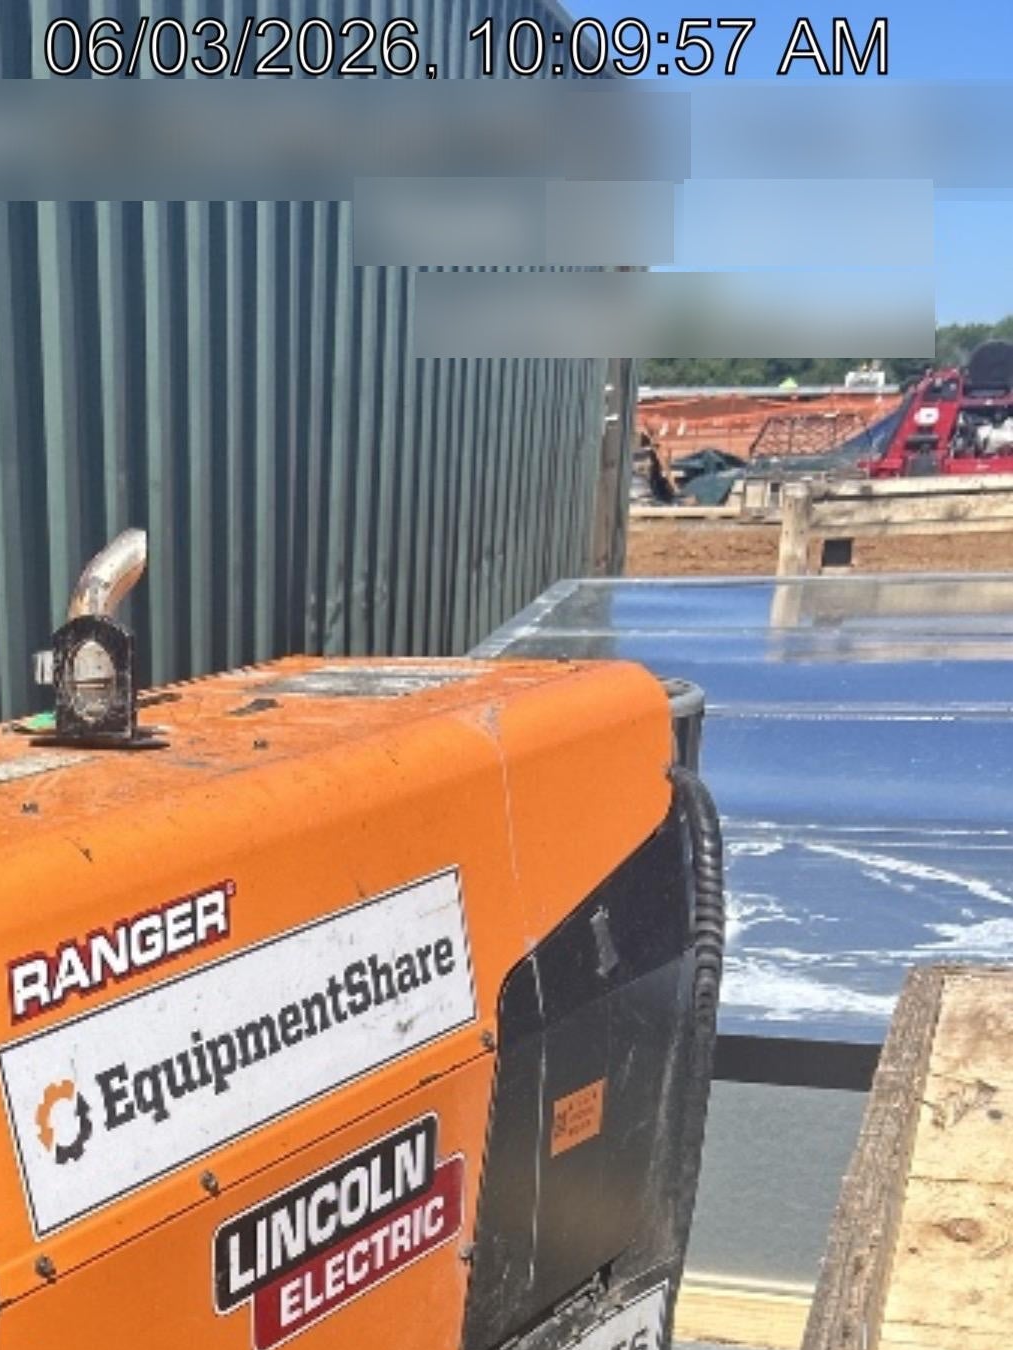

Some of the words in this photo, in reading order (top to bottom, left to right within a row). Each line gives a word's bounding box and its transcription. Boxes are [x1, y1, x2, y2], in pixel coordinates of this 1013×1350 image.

[10, 887, 229, 1017] RANGER
[94, 936, 455, 1131] EquipmentShare
[228, 1130, 427, 1295] LINCOLN
[279, 1195, 445, 1328] ELECTRIC
